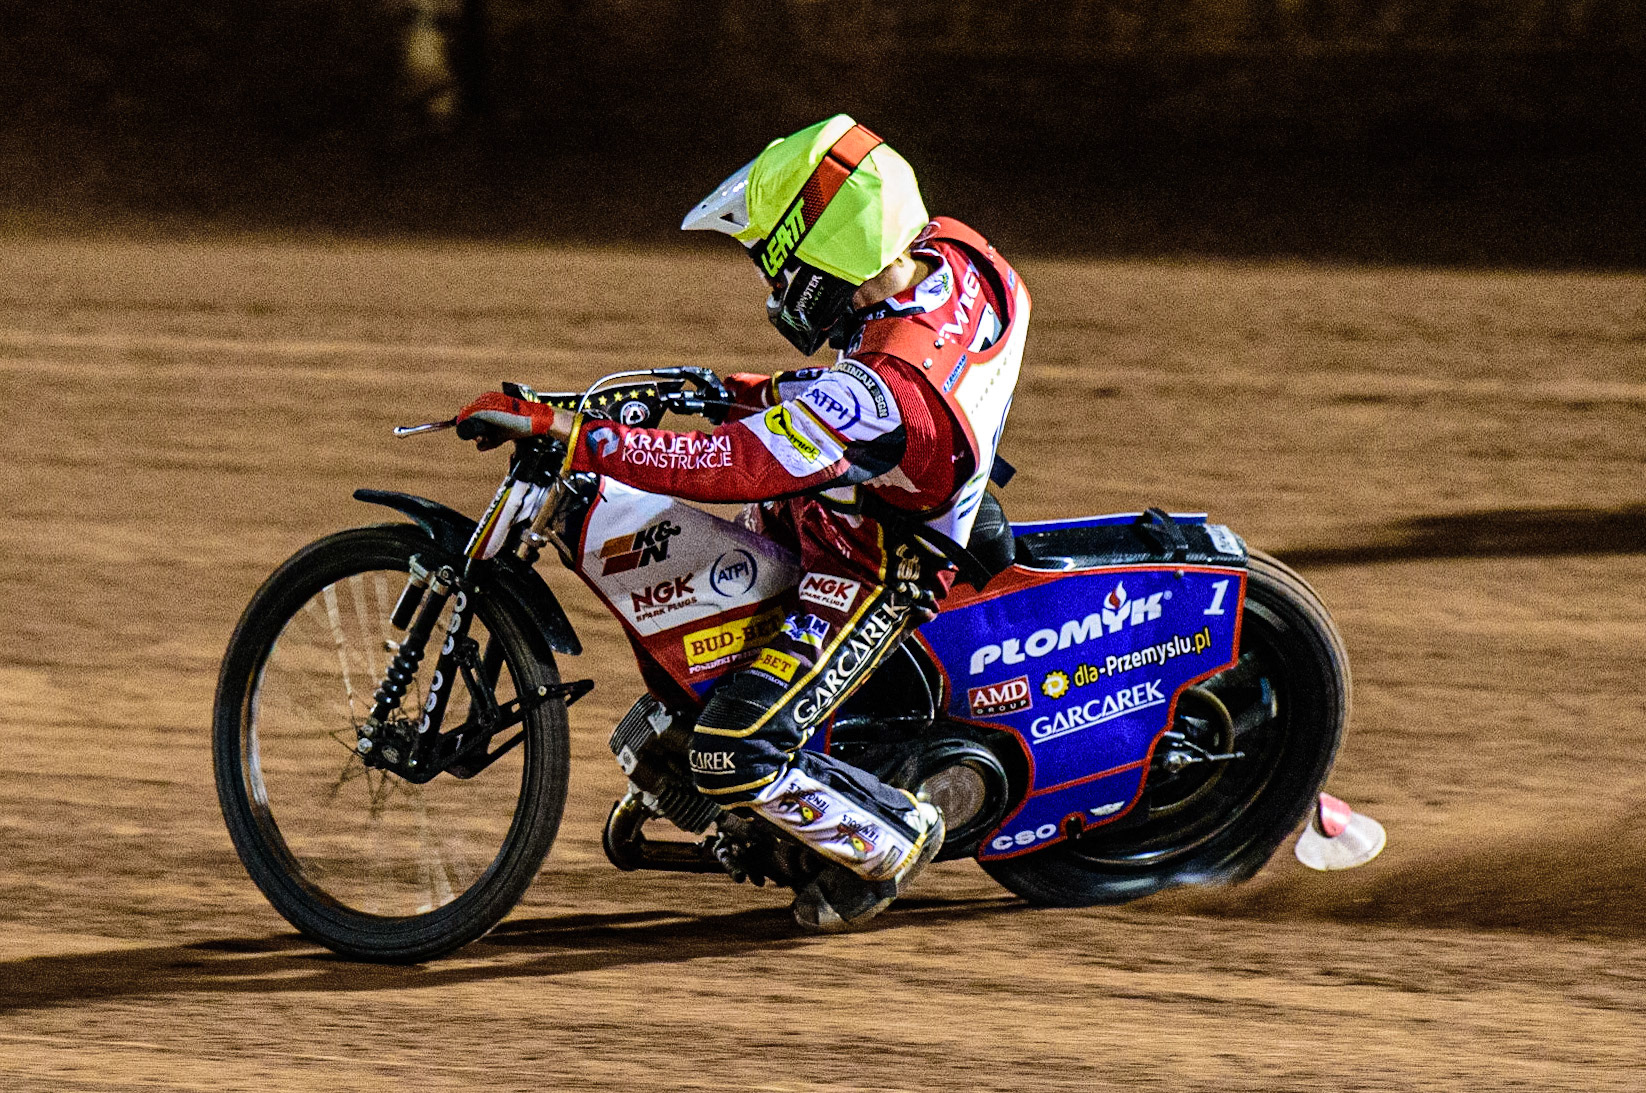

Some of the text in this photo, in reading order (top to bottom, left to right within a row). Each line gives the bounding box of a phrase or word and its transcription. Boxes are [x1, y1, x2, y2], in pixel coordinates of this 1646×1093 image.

[761, 197, 806, 277] LEATT
[805, 388, 849, 420] ATPI
[622, 447, 733, 469] KONSTRUKCJE
[717, 561, 749, 584] ATPI
[631, 572, 694, 613] NGK
[803, 576, 854, 600] NGK
[1203, 579, 1229, 615] 1
[667, 597, 698, 612] PLUGS
[793, 593, 909, 725] GARCAREK
[973, 680, 1028, 708] AMD
[976, 699, 1028, 715] GROUP
[1030, 679, 1165, 740] GARCAREK
[992, 823, 1057, 850] CSO
